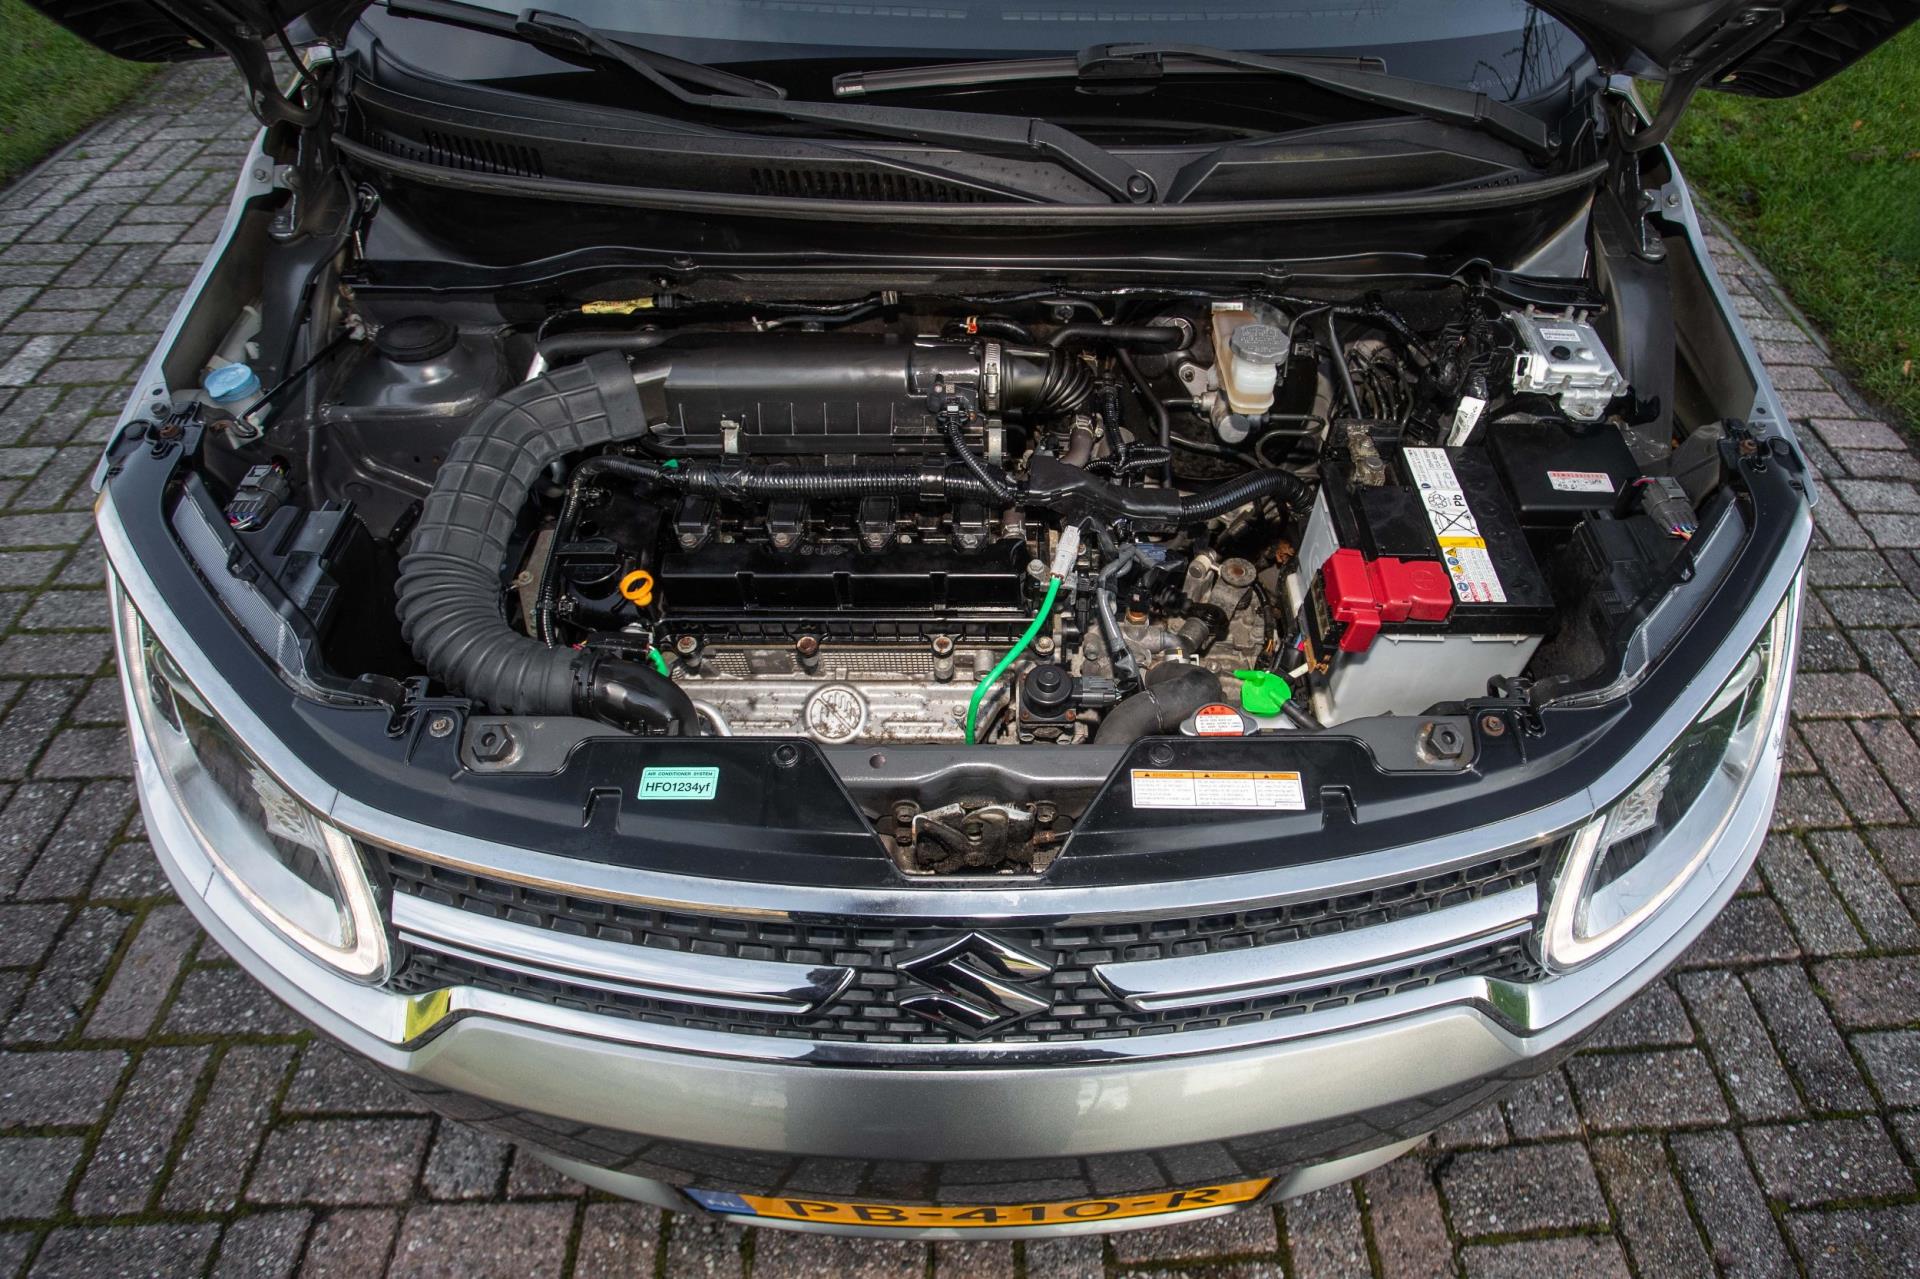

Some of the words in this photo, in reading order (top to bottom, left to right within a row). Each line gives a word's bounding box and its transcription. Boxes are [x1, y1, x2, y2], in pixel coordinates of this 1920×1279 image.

[1453, 494, 1465, 506] Pb
[645, 782, 711, 793] HFO1234yf
[784, 1189, 1221, 1223] PB-410-R
